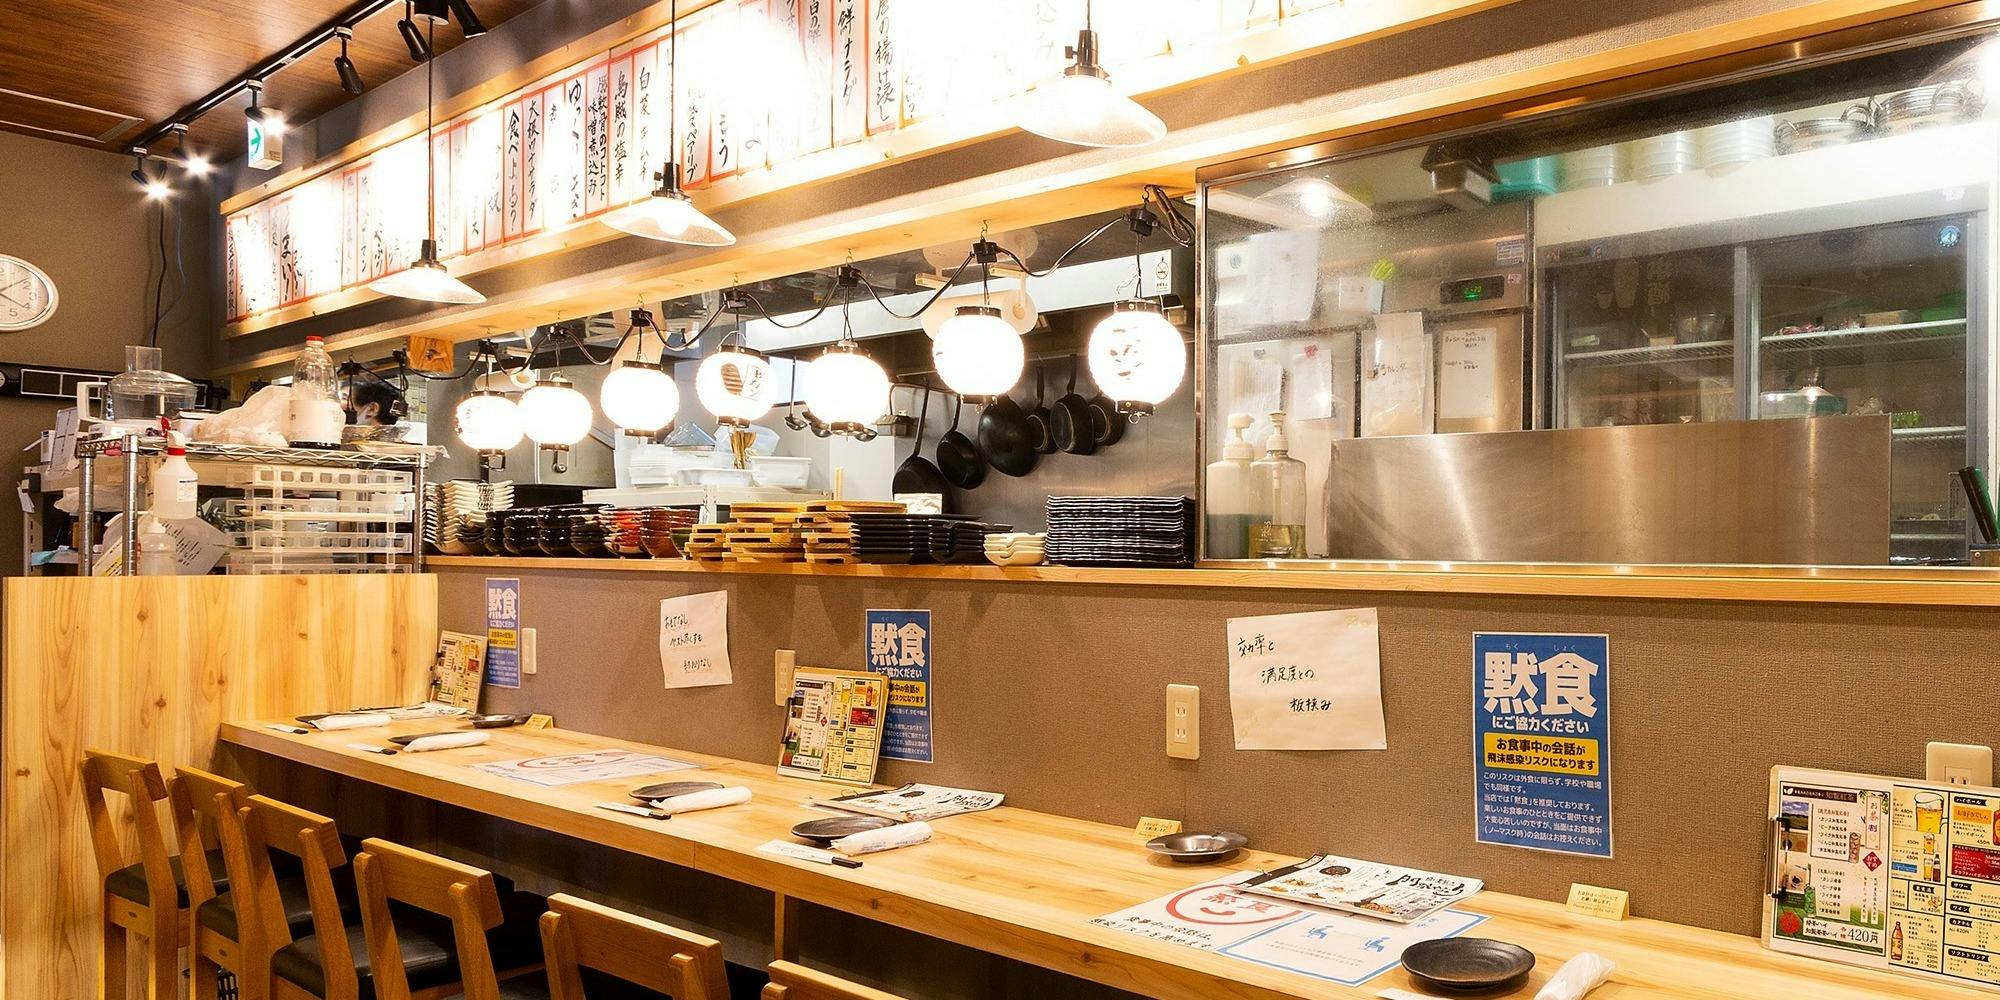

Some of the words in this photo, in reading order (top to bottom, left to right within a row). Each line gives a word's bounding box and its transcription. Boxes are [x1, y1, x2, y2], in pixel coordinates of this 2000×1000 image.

[9, 308, 18, 317] 5
[871, 622, 926, 667] 黙食
[1238, 633, 1275, 657] 効率と
[1260, 665, 1315, 684] 満足度との
[1483, 652, 1599, 718] 黙食
[1289, 698, 1332, 713] 板挟み
[1492, 715, 1590, 734] にご協力ください
[1496, 737, 1586, 756] お食事中の会話が
[1487, 752, 1595, 771] 飛沫感染リスクになります
[1483, 771, 1602, 790] このリスクは外食に限らず、学校や職場
[1483, 782, 1527, 794] でも同様です。
[1484, 794, 1595, 812] 当店では「黙食」を推奨しております。
[1483, 804, 1603, 824] 楽しいお食事のひとときをご提供できず
[1484, 816, 1603, 836] 大変心苦しいのですが、当面はお食事中
[1952, 919, 1970, 927] カクテル
[1848, 928, 1879, 944] 420円
[1951, 950, 1986, 960] ソフトドリンク
